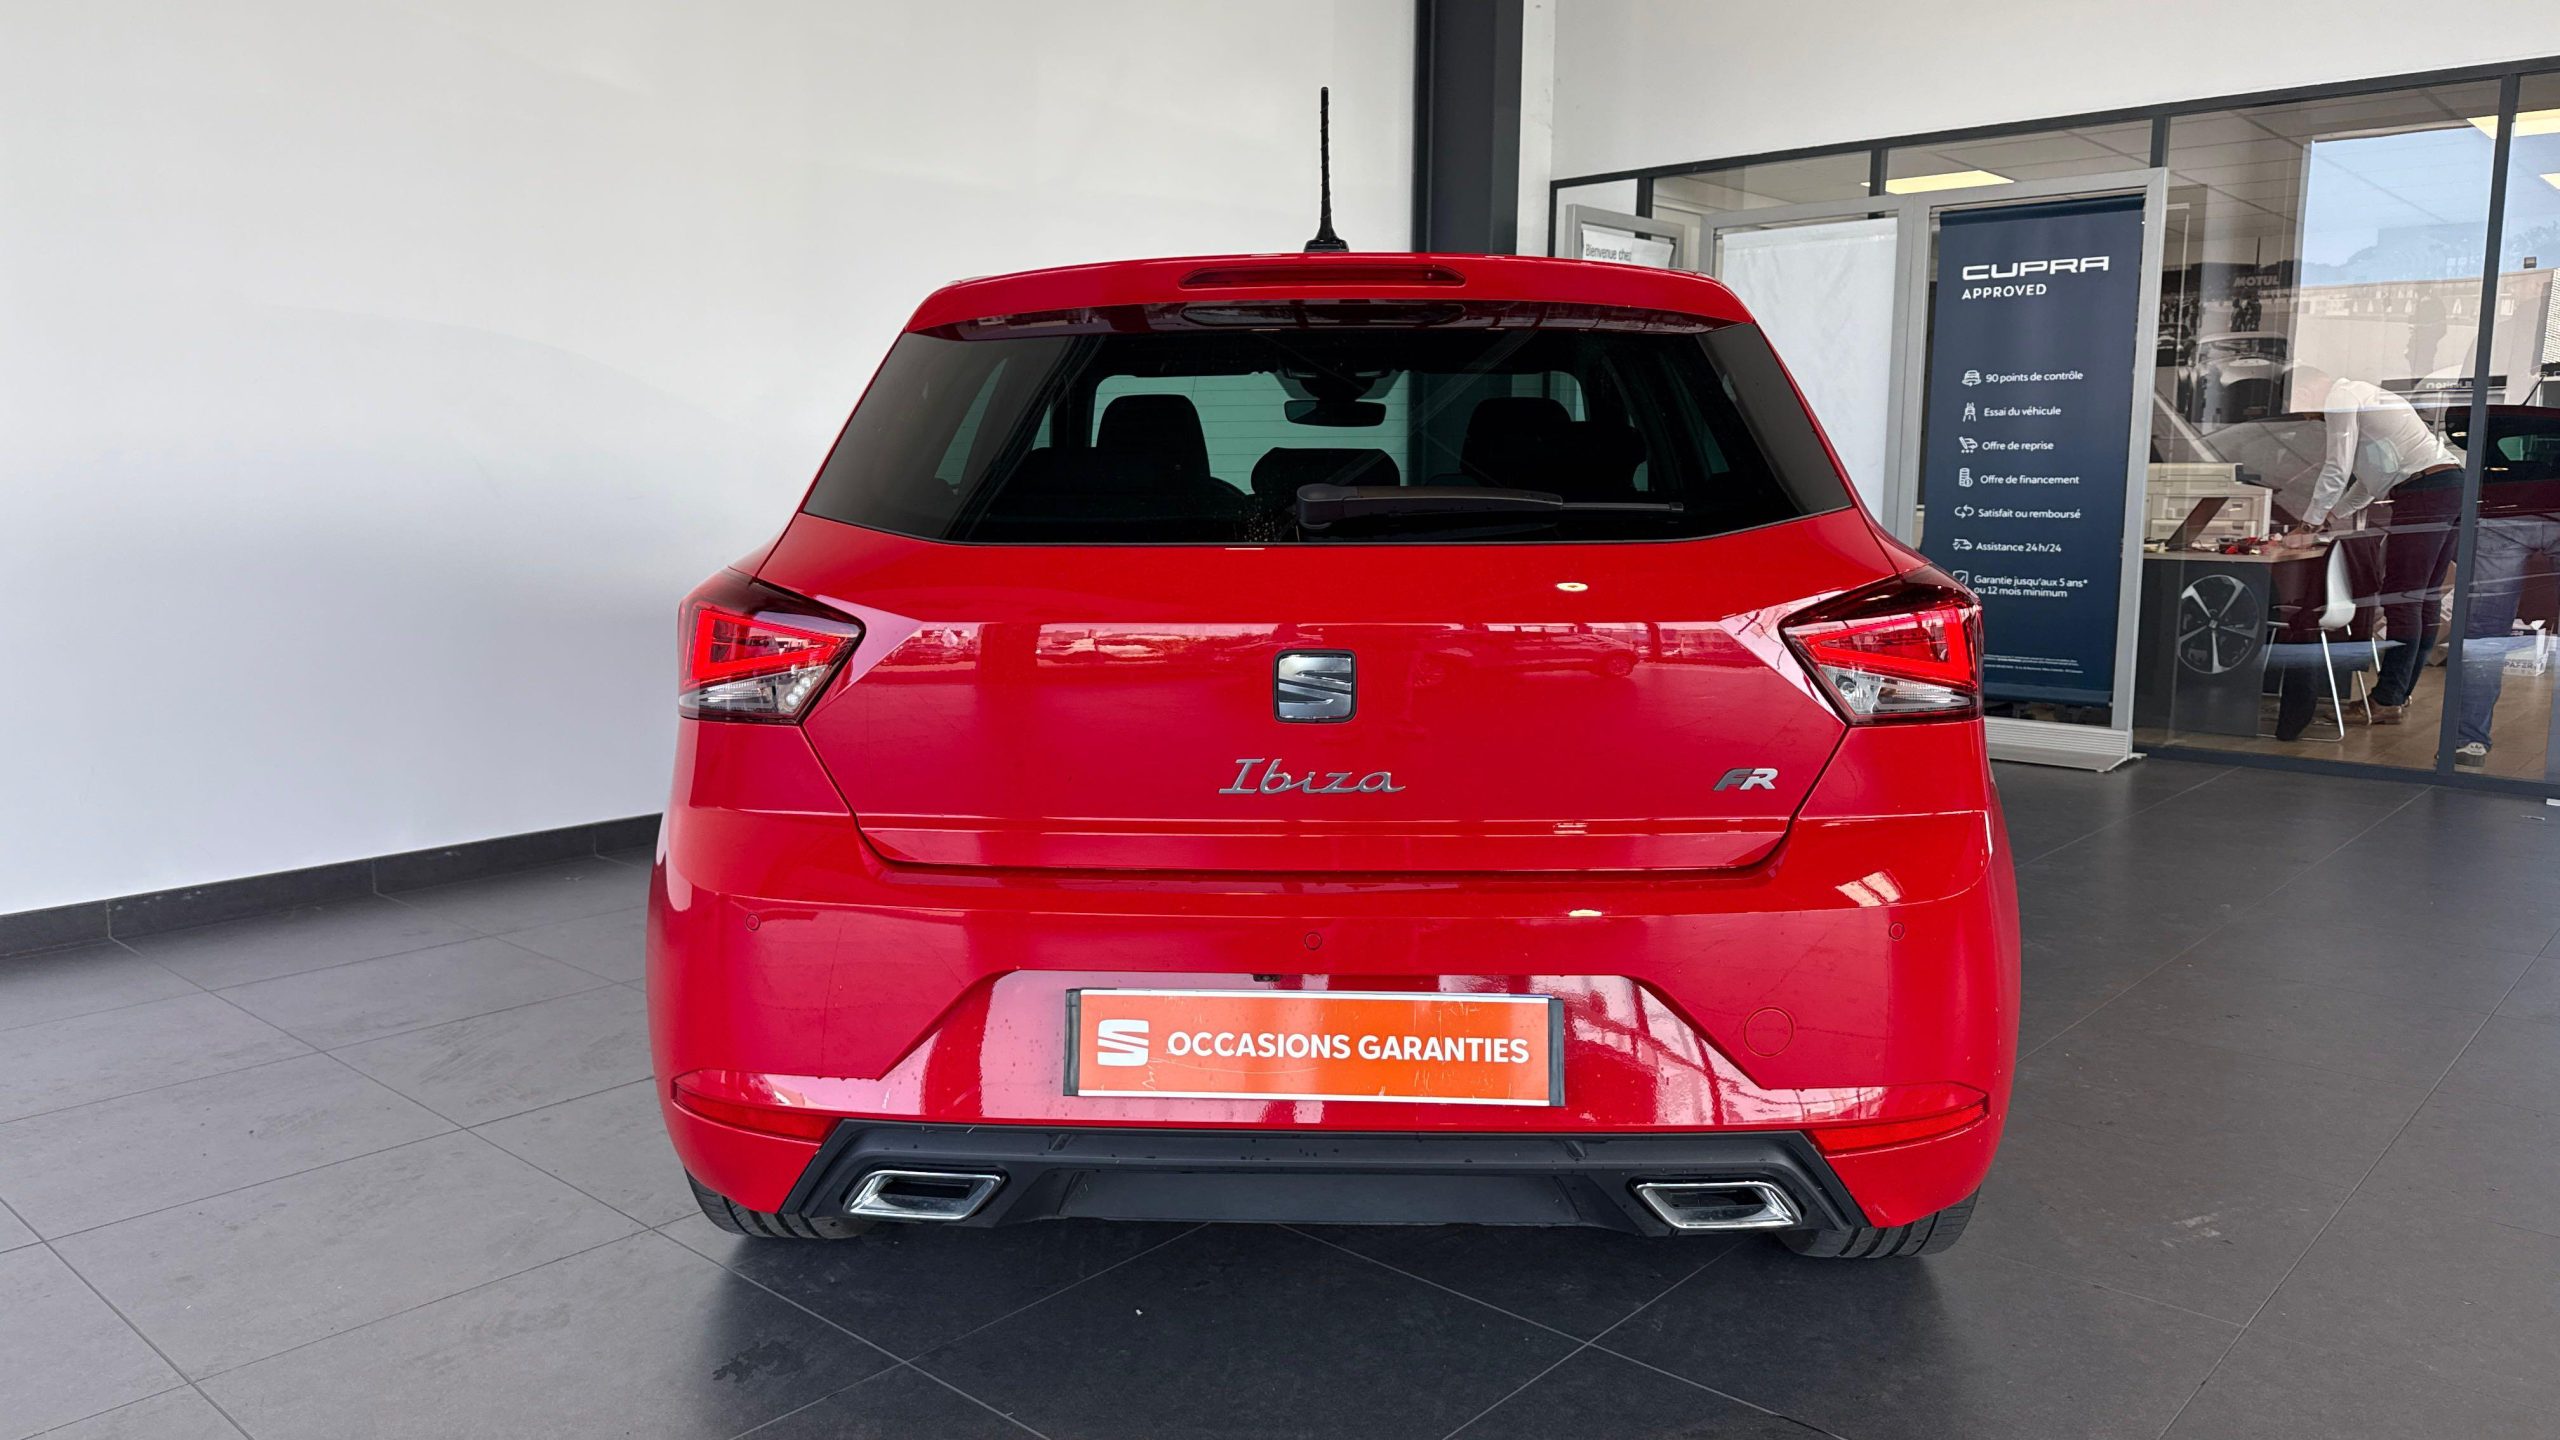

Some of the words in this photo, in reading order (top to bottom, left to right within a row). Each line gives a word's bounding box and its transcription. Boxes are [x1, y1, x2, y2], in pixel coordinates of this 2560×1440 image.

[1585, 243, 1617, 260] Bienvenue
[1962, 255, 2110, 281] CUPRA
[2233, 275, 2280, 287] MOTUL
[1961, 283, 2047, 300] APPROVED
[1985, 374, 1999, 383] 90
[1999, 373, 2029, 384] points
[2029, 372, 2043, 381] de
[2043, 370, 2084, 381] contrôle
[1983, 407, 2007, 417] Essai
[2007, 407, 2021, 416] du
[2021, 405, 2062, 416] véhicule
[1982, 441, 2006, 451] Offre
[2007, 441, 2020, 450] de
[2021, 440, 2055, 452] reprise
[1980, 475, 2005, 484] Offre
[2005, 475, 2018, 484] de
[2019, 475, 2080, 484] financement
[1978, 508, 2014, 518] Satisfait
[2014, 510, 2028, 518] ou
[2029, 508, 2081, 519] remboursé
[1976, 542, 2025, 552] Assistance
[1974, 574, 2013, 585] Garantie
[2013, 577, 2058, 587] jusqu'aux
[2058, 578, 2066, 587] 5
[1973, 586, 1987, 594] ou
[1987, 586, 1998, 595] 12
[1998, 587, 2021, 596] mois
[2022, 588, 2068, 598] minimum
[1218, 757, 1406, 795] Ibiza
[1712, 767, 1779, 792] FR
[1166, 1031, 1352, 1060] OCCASIONS
[1357, 1036, 1530, 1064] GARANTIES
